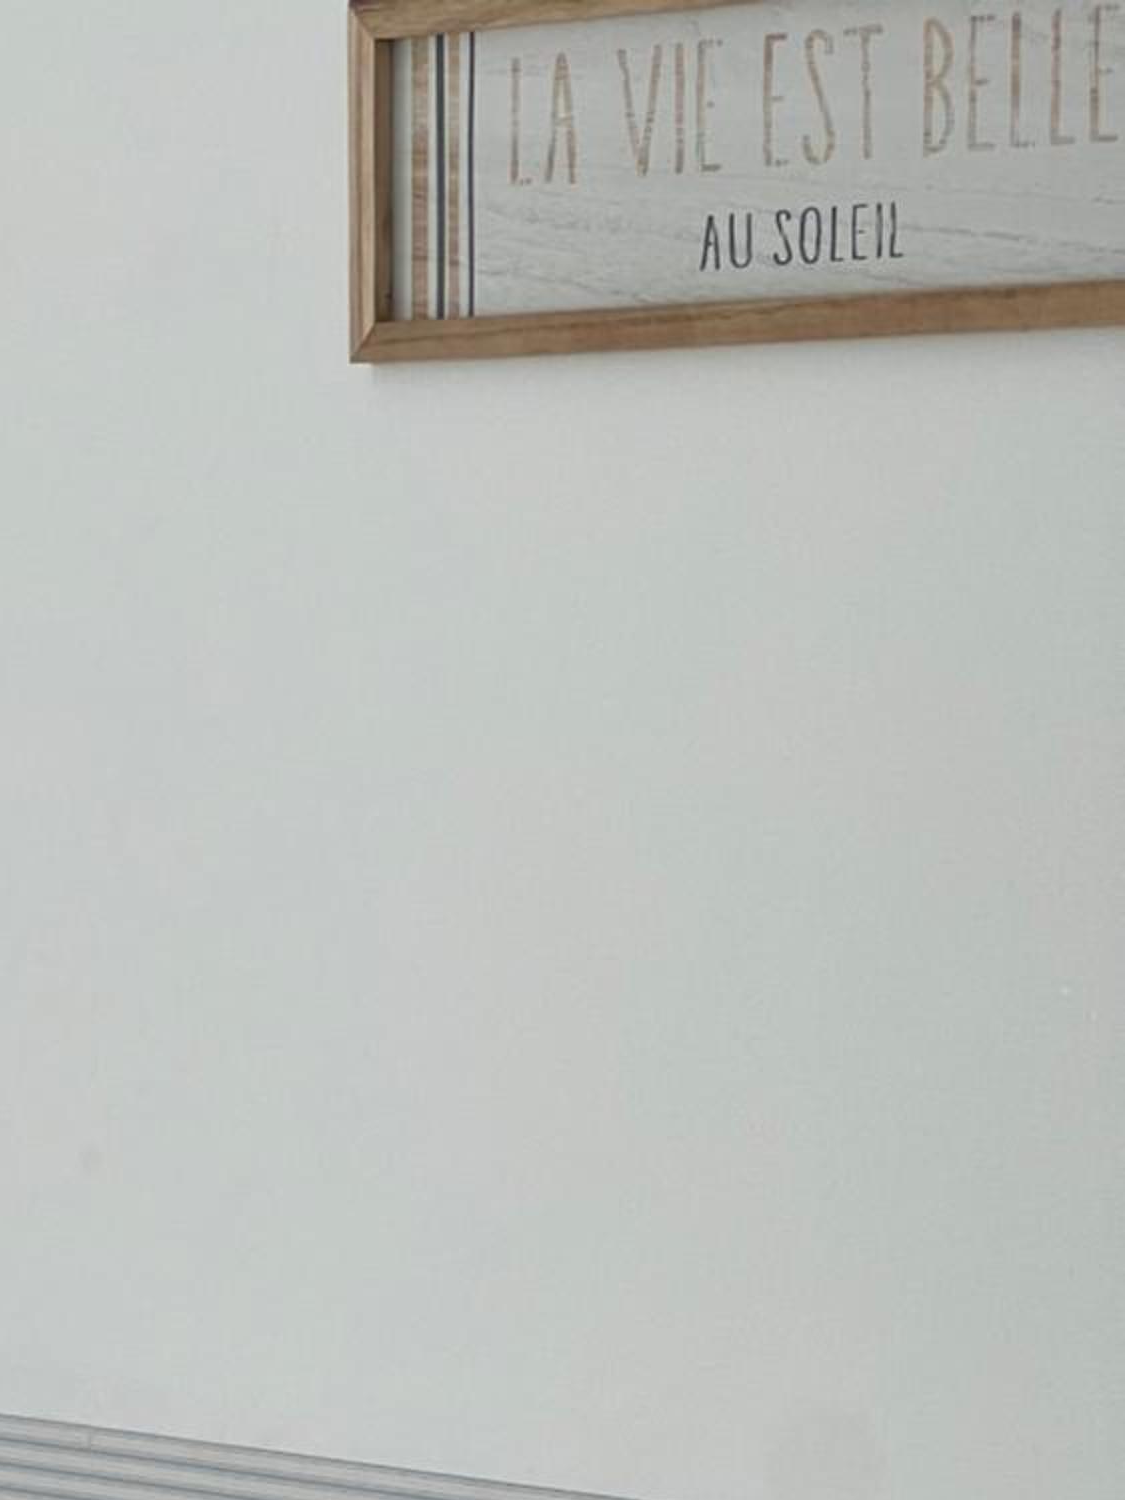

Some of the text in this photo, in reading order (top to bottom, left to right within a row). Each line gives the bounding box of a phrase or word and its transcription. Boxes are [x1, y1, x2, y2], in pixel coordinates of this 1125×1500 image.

[509, 4, 1121, 187] LA VIE EST BELLE
[699, 201, 904, 272] AU SOLEIL
